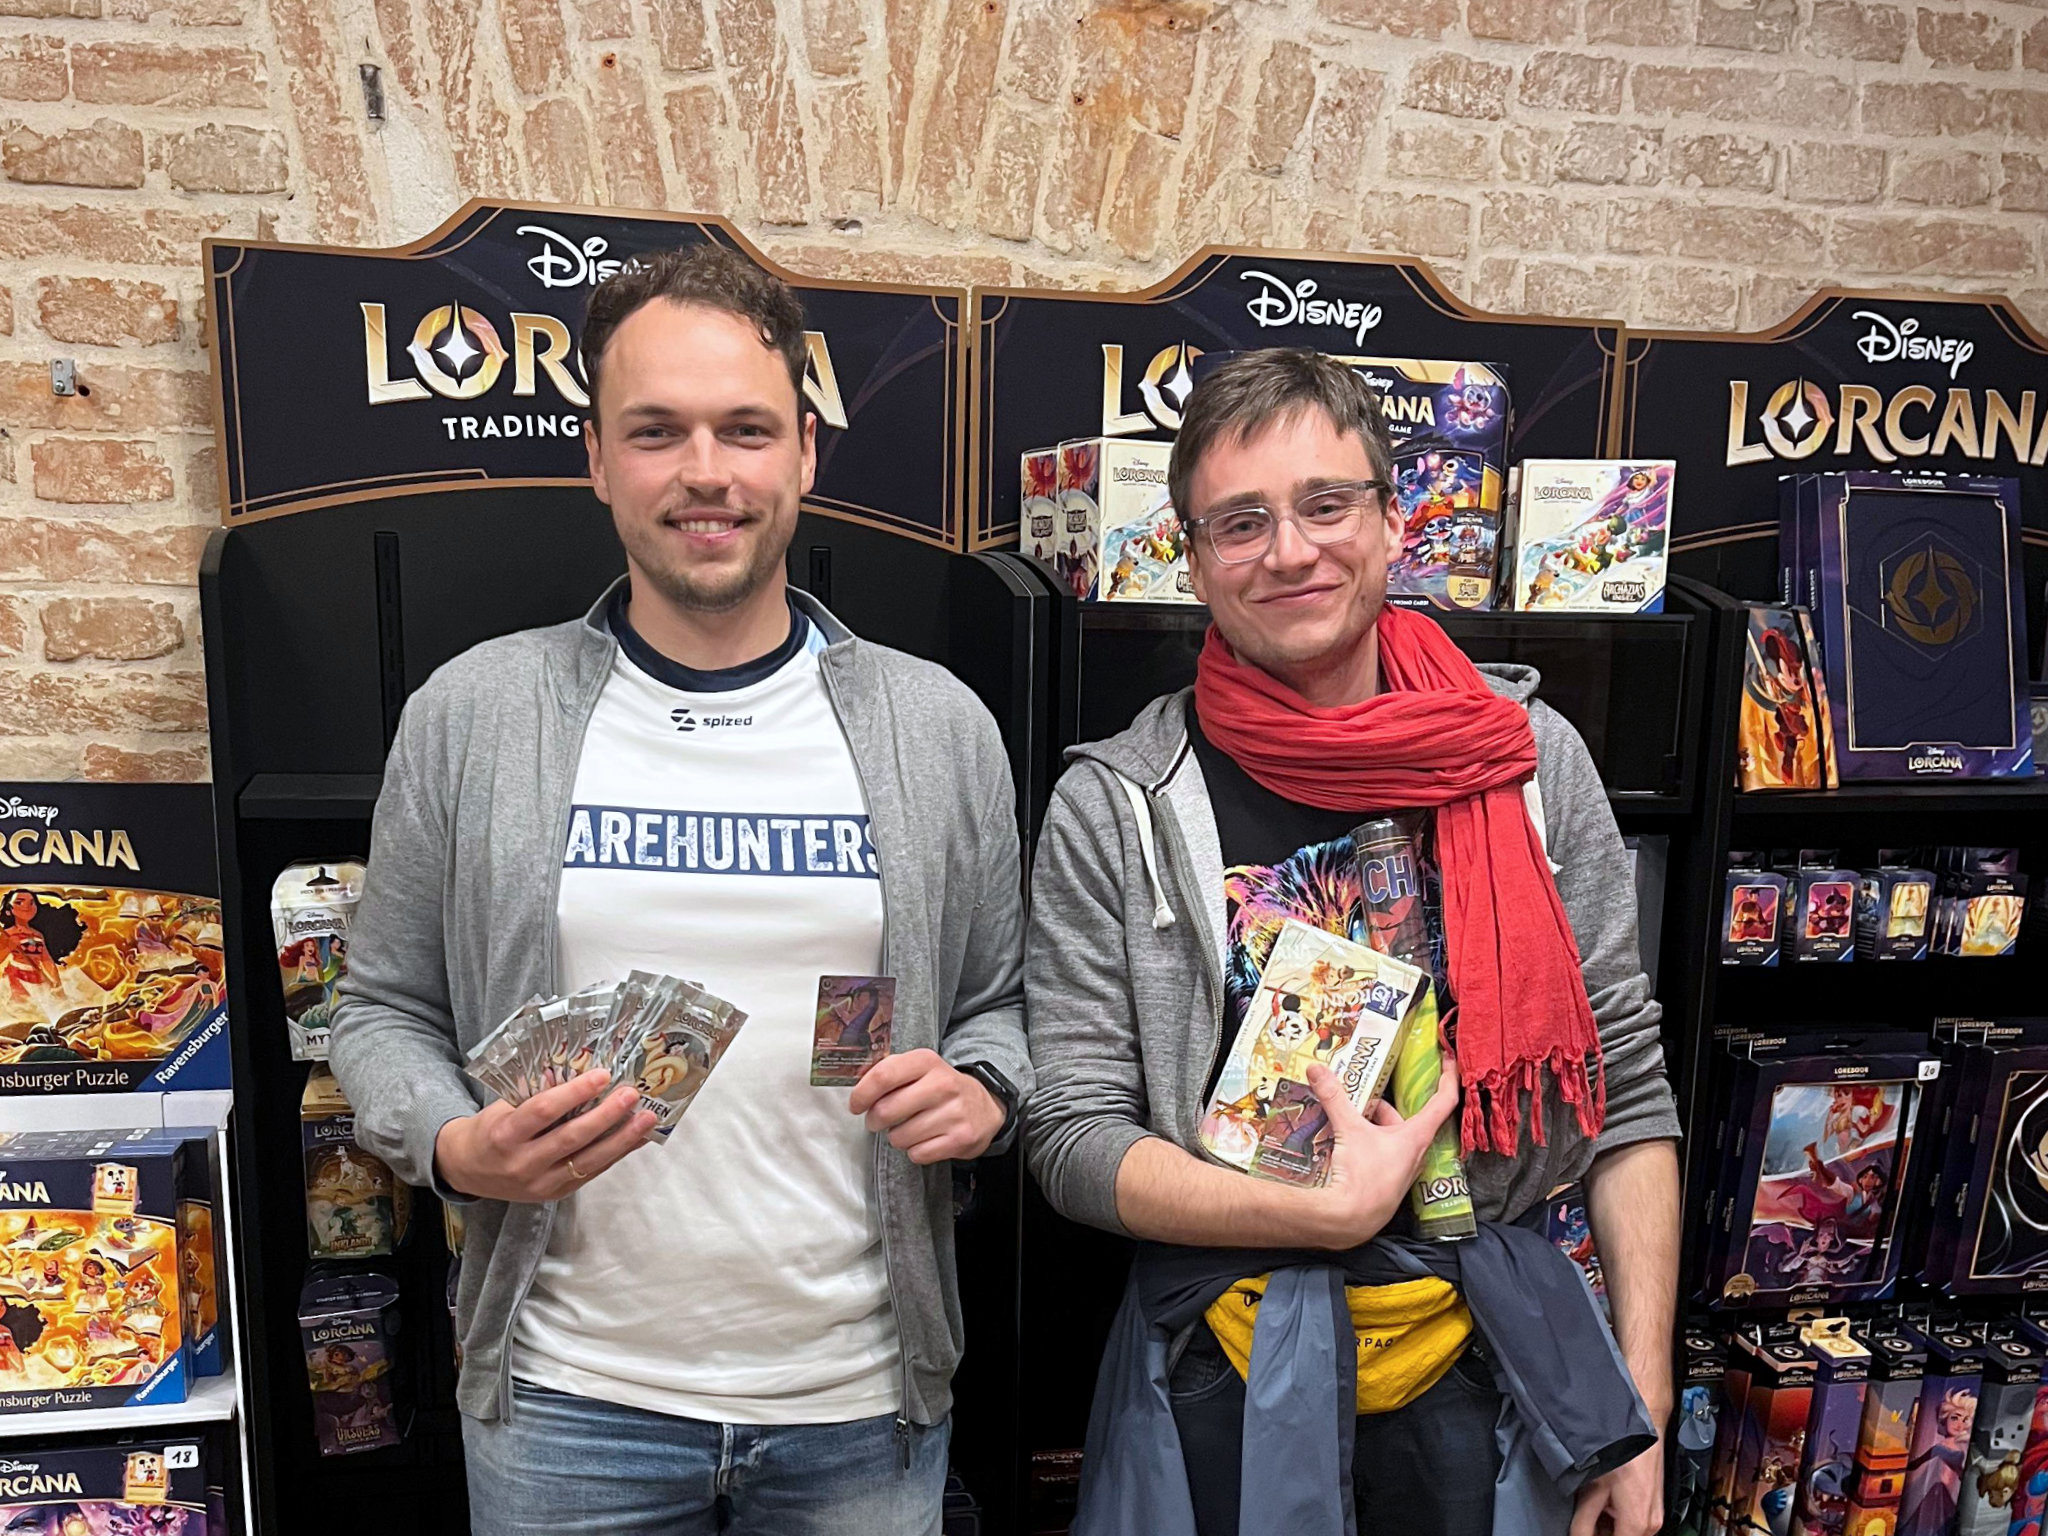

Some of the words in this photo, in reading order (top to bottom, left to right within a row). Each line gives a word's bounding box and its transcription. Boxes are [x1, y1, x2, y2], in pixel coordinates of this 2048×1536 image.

[1240, 271, 1382, 347] Disney
[1852, 311, 1974, 380] Disney
[442, 415, 580, 440] TRADING
[1112, 466, 1168, 484] LORCANA
[1533, 486, 1594, 501] LORCANA
[702, 715, 753, 729] spized
[1908, 756, 1963, 770] LORCANA
[1362, 854, 1421, 904] CH
[154, 1011, 230, 1085] Ravensburger
[306, 1033, 330, 1046] MY
[76, 1069, 129, 1086] Puzzle
[314, 1125, 355, 1138] LORC
[311, 1322, 376, 1343] LORCANA
[55, 1391, 92, 1405] Puzzle
[171, 1450, 193, 1465] 18
